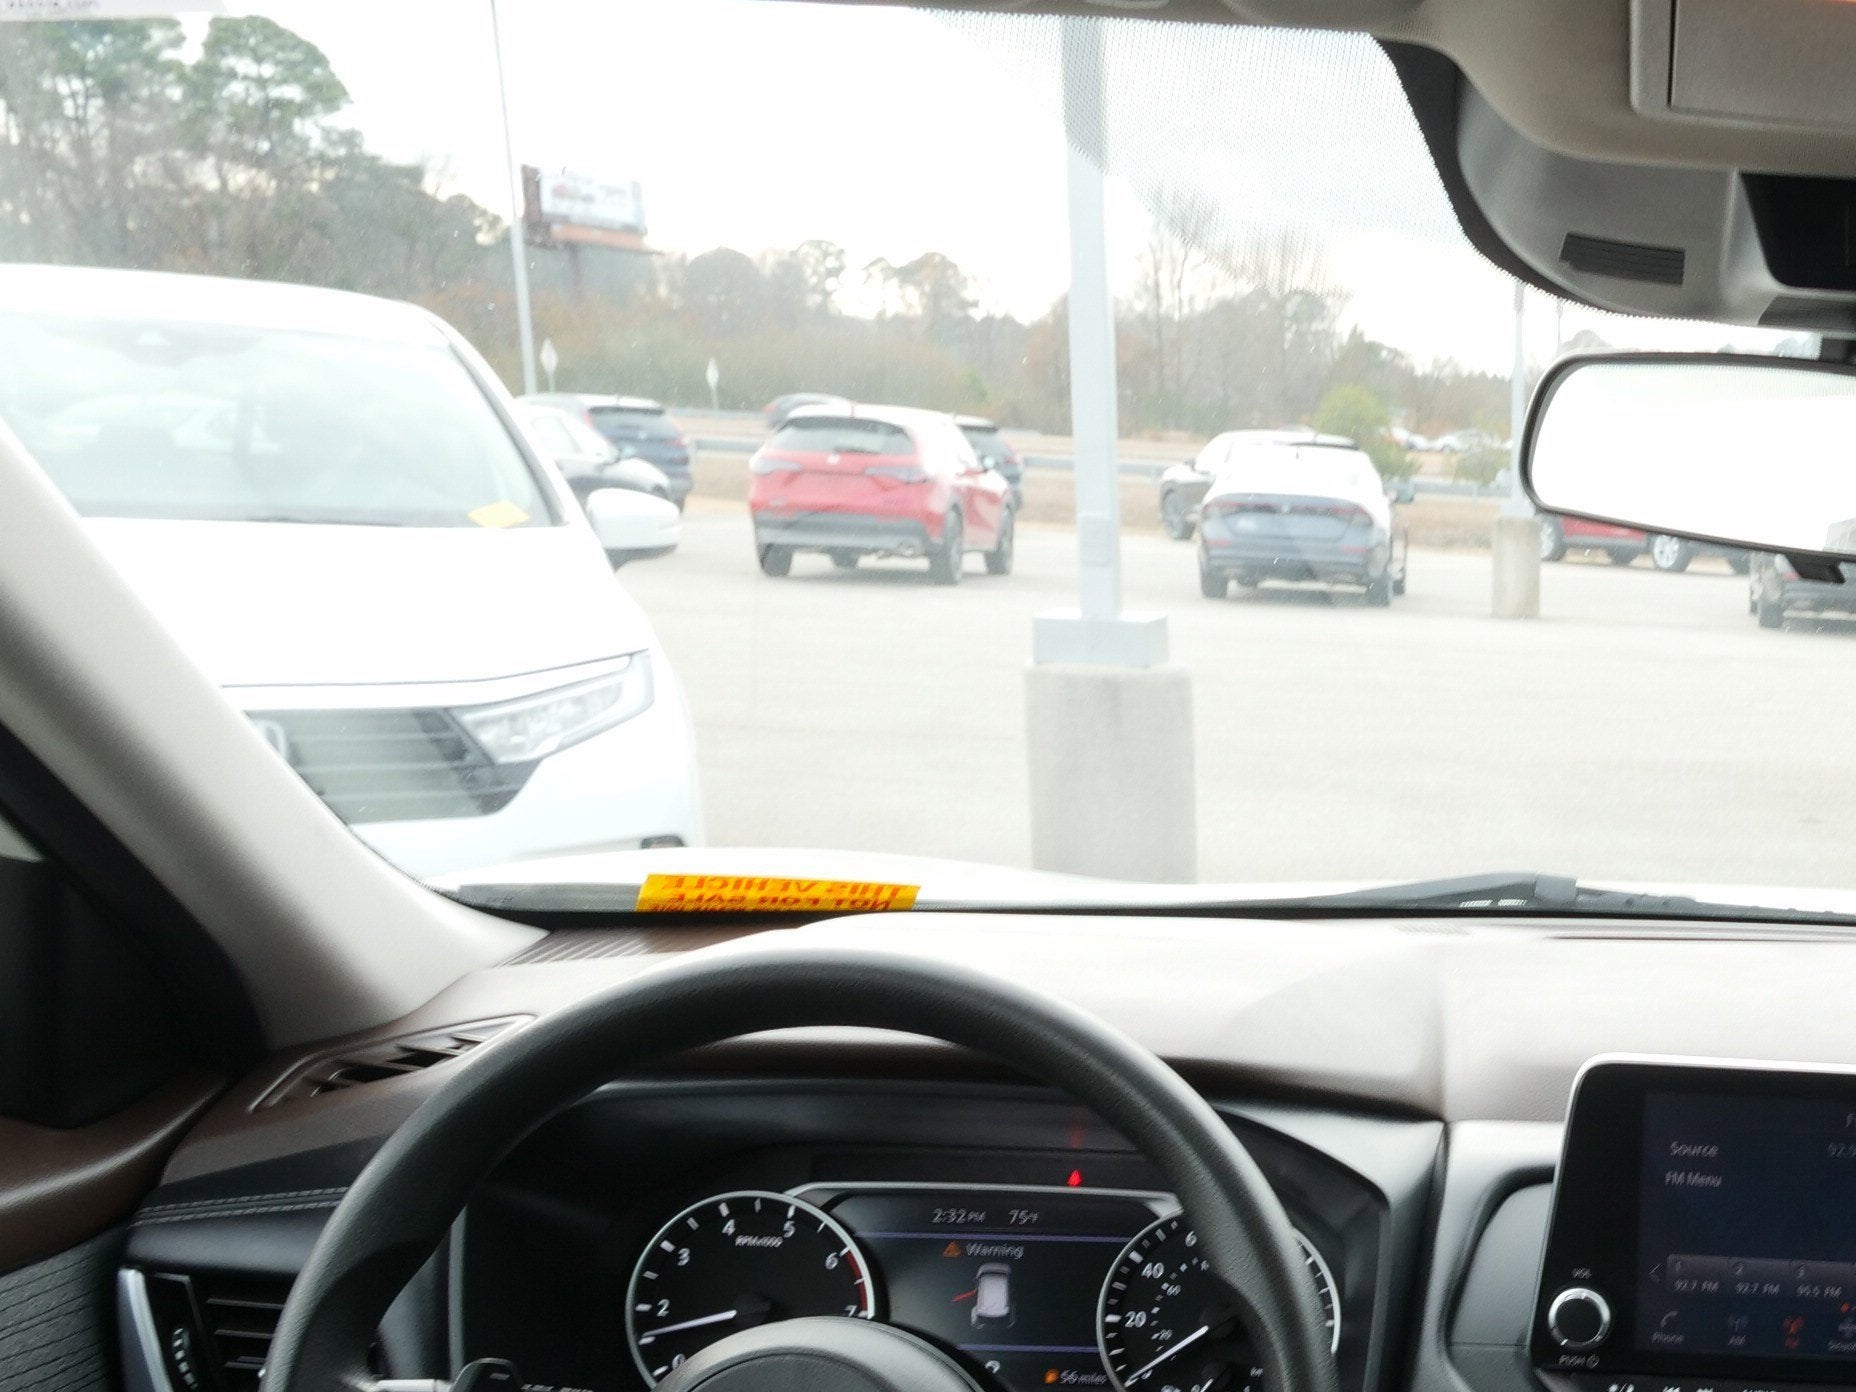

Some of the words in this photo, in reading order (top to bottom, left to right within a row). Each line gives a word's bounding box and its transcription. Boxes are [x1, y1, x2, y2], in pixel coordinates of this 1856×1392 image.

[1669, 1141, 1720, 1158] Source
[1686, 1170, 1723, 1188] Menu
[721, 1219, 737, 1237] 4
[782, 1220, 797, 1239] 5
[677, 1247, 693, 1267] 3
[965, 1242, 1025, 1260] Warning
[824, 1252, 840, 1271] 6
[1141, 1261, 1165, 1280] 40
[656, 1298, 671, 1318] 2
[1124, 1310, 1147, 1329] 20
